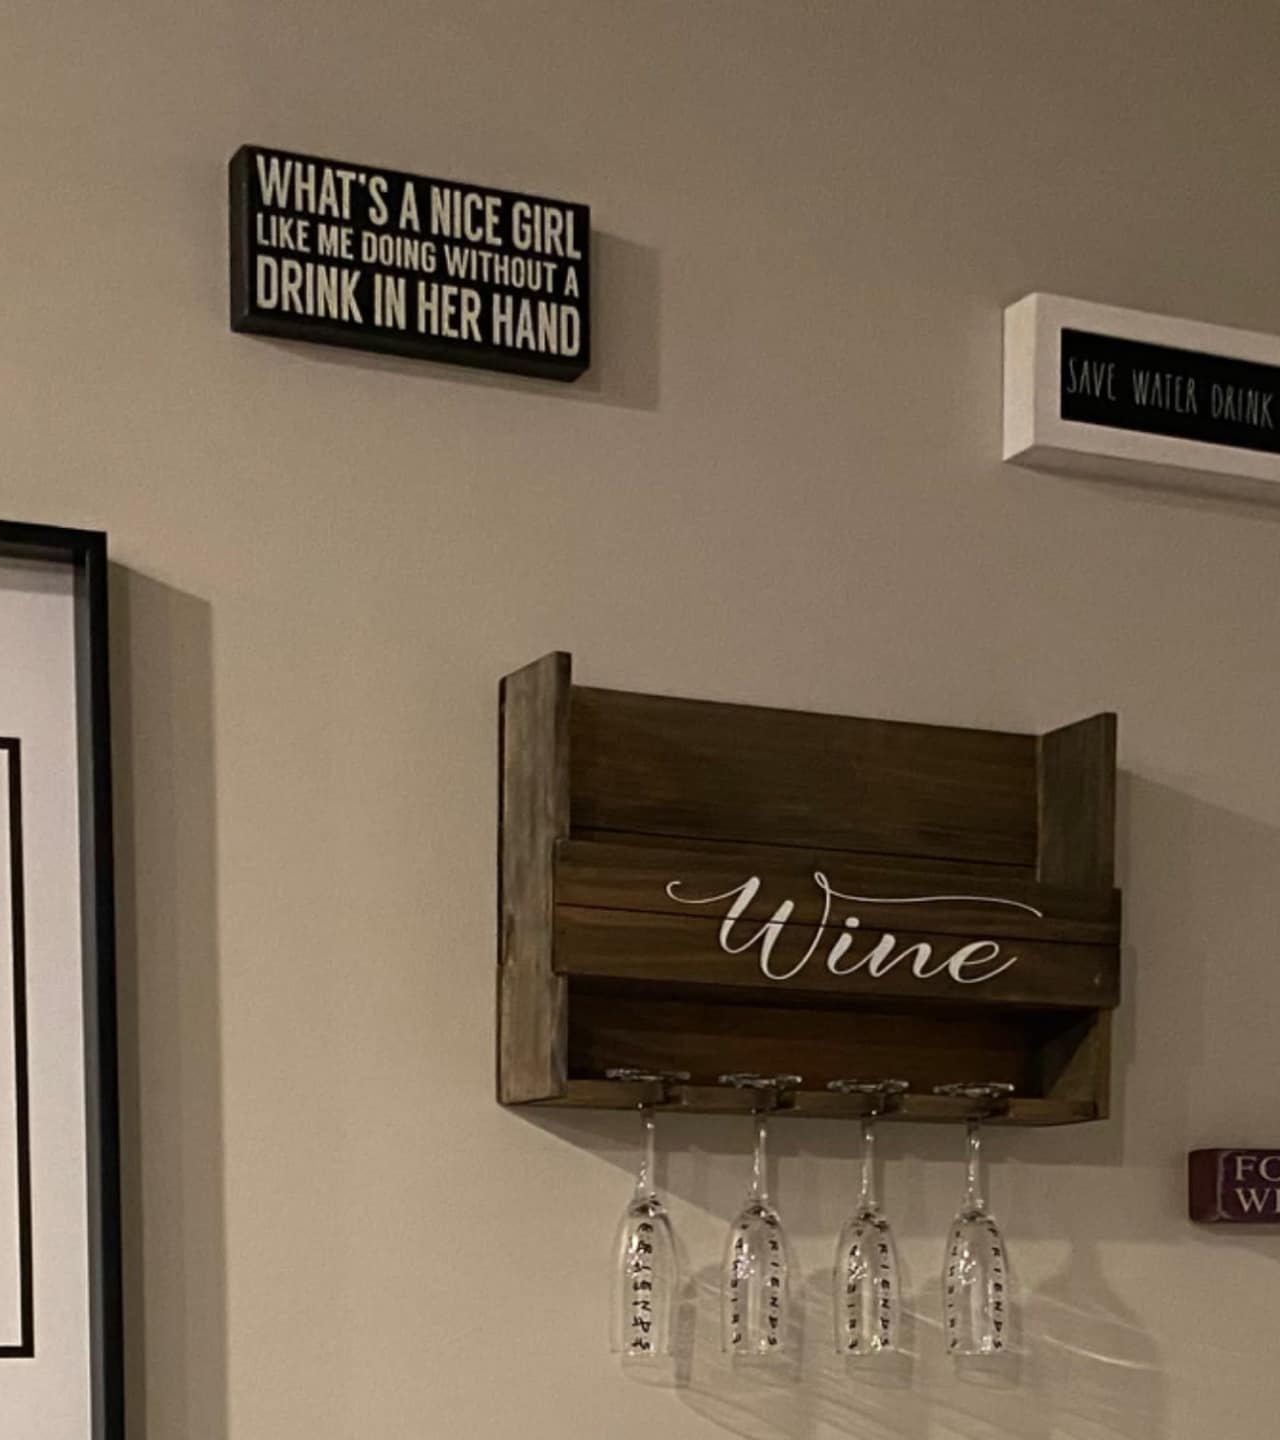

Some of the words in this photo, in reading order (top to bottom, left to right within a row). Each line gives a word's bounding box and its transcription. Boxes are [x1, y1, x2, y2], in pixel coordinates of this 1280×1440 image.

[256, 154, 388, 225] WHAT'S
[399, 181, 420, 233] A
[431, 186, 503, 246] NICE
[512, 201, 582, 260] GIRL
[256, 212, 311, 252] LIKE
[318, 224, 354, 260] ME
[361, 232, 436, 274] DOING
[444, 244, 557, 294] WITHOUT
[564, 266, 580, 298] A
[256, 255, 363, 324] DRINK
[374, 273, 407, 330] IN
[418, 281, 482, 343] HER
[492, 293, 581, 357] HAND
[1066, 357, 1117, 401] SAVE
[1132, 368, 1198, 415] WATER
[1211, 384, 1274, 430] DRINK
[666, 871, 1043, 984] Wine
